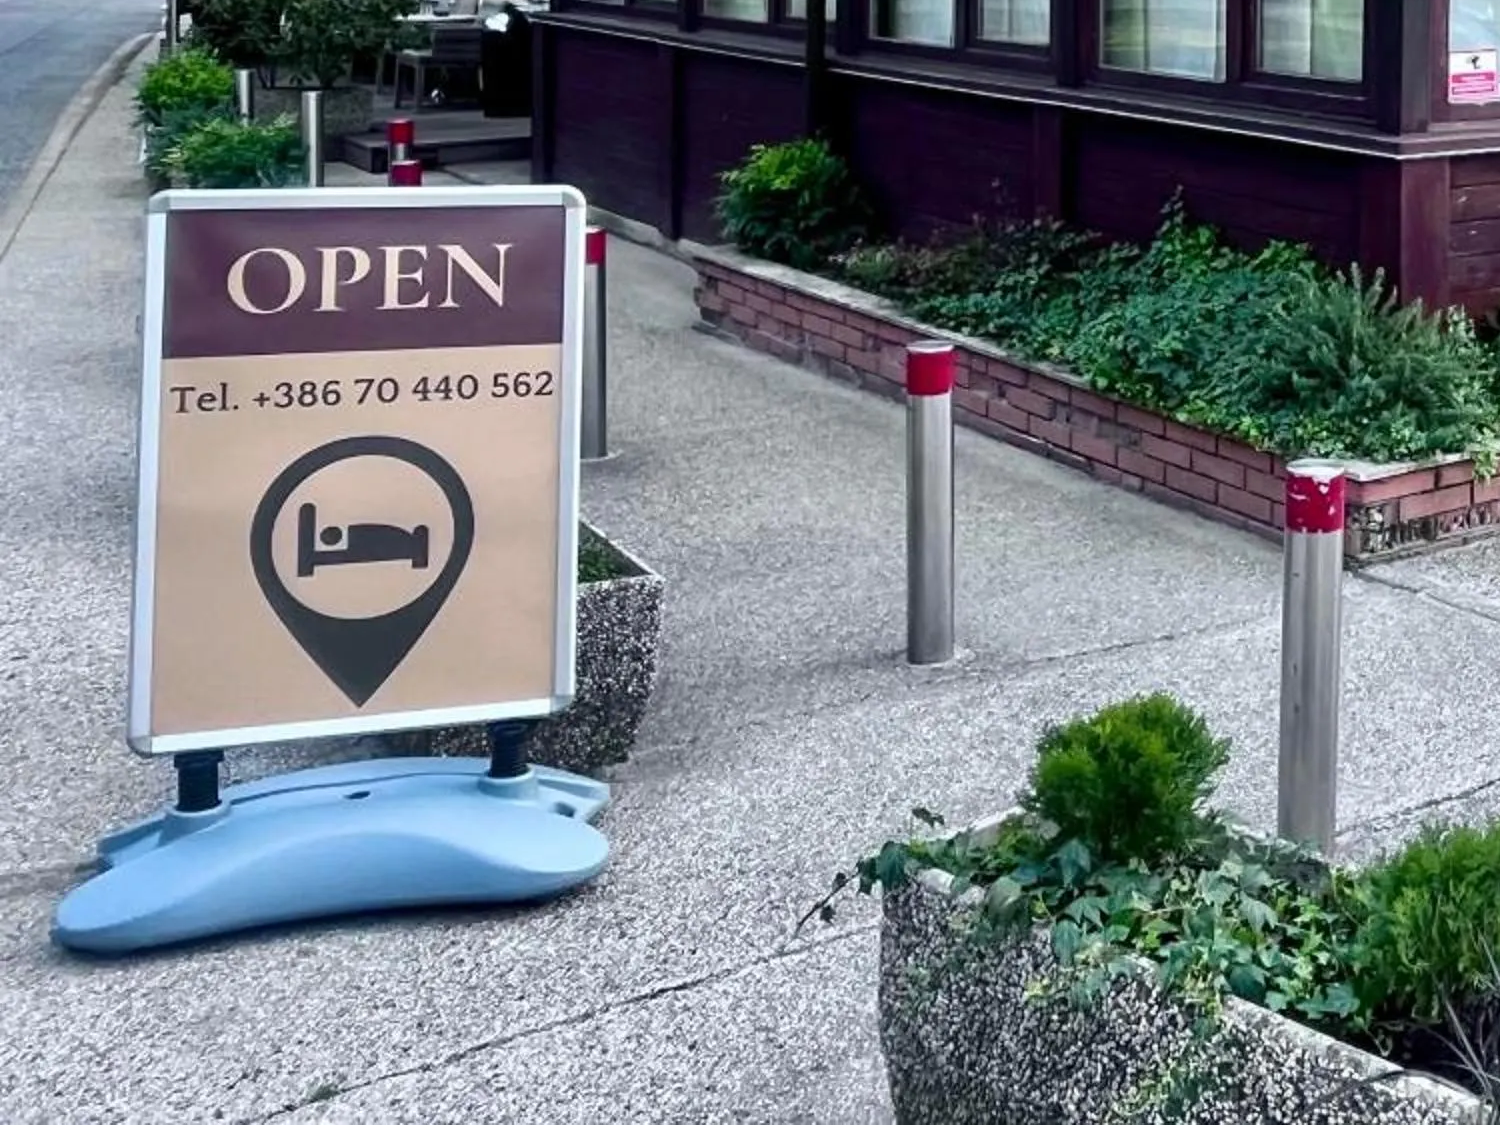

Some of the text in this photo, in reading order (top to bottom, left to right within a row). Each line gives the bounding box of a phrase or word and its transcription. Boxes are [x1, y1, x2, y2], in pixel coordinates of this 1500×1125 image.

[227, 243, 514, 314] OPEN
[170, 370, 554, 413] Tel. +386 70 440 562
